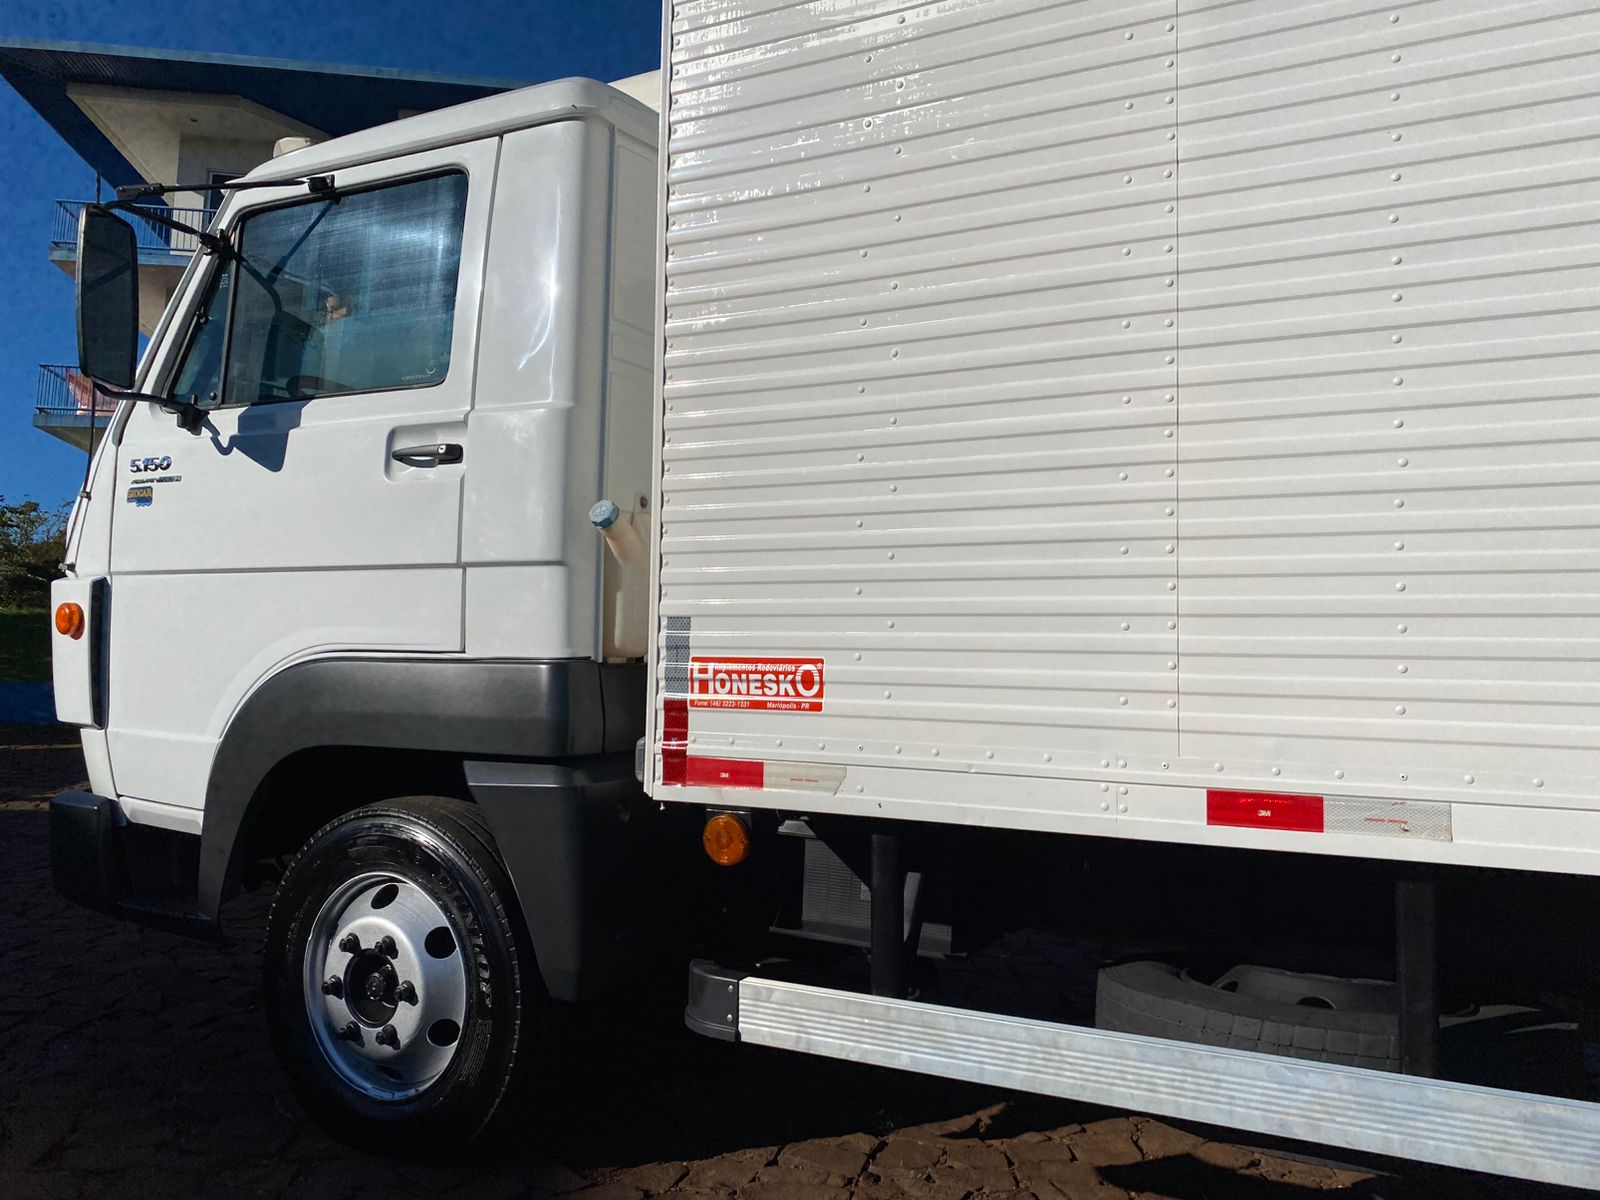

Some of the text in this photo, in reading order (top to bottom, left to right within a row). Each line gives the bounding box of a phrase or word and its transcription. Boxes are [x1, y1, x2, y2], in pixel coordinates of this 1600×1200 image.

[757, 663, 795, 672] Rodoviários
[766, 701, 797, 710] Mariópolis
[800, 702, 810, 710] PR
[1258, 809, 1271, 817] 3M
